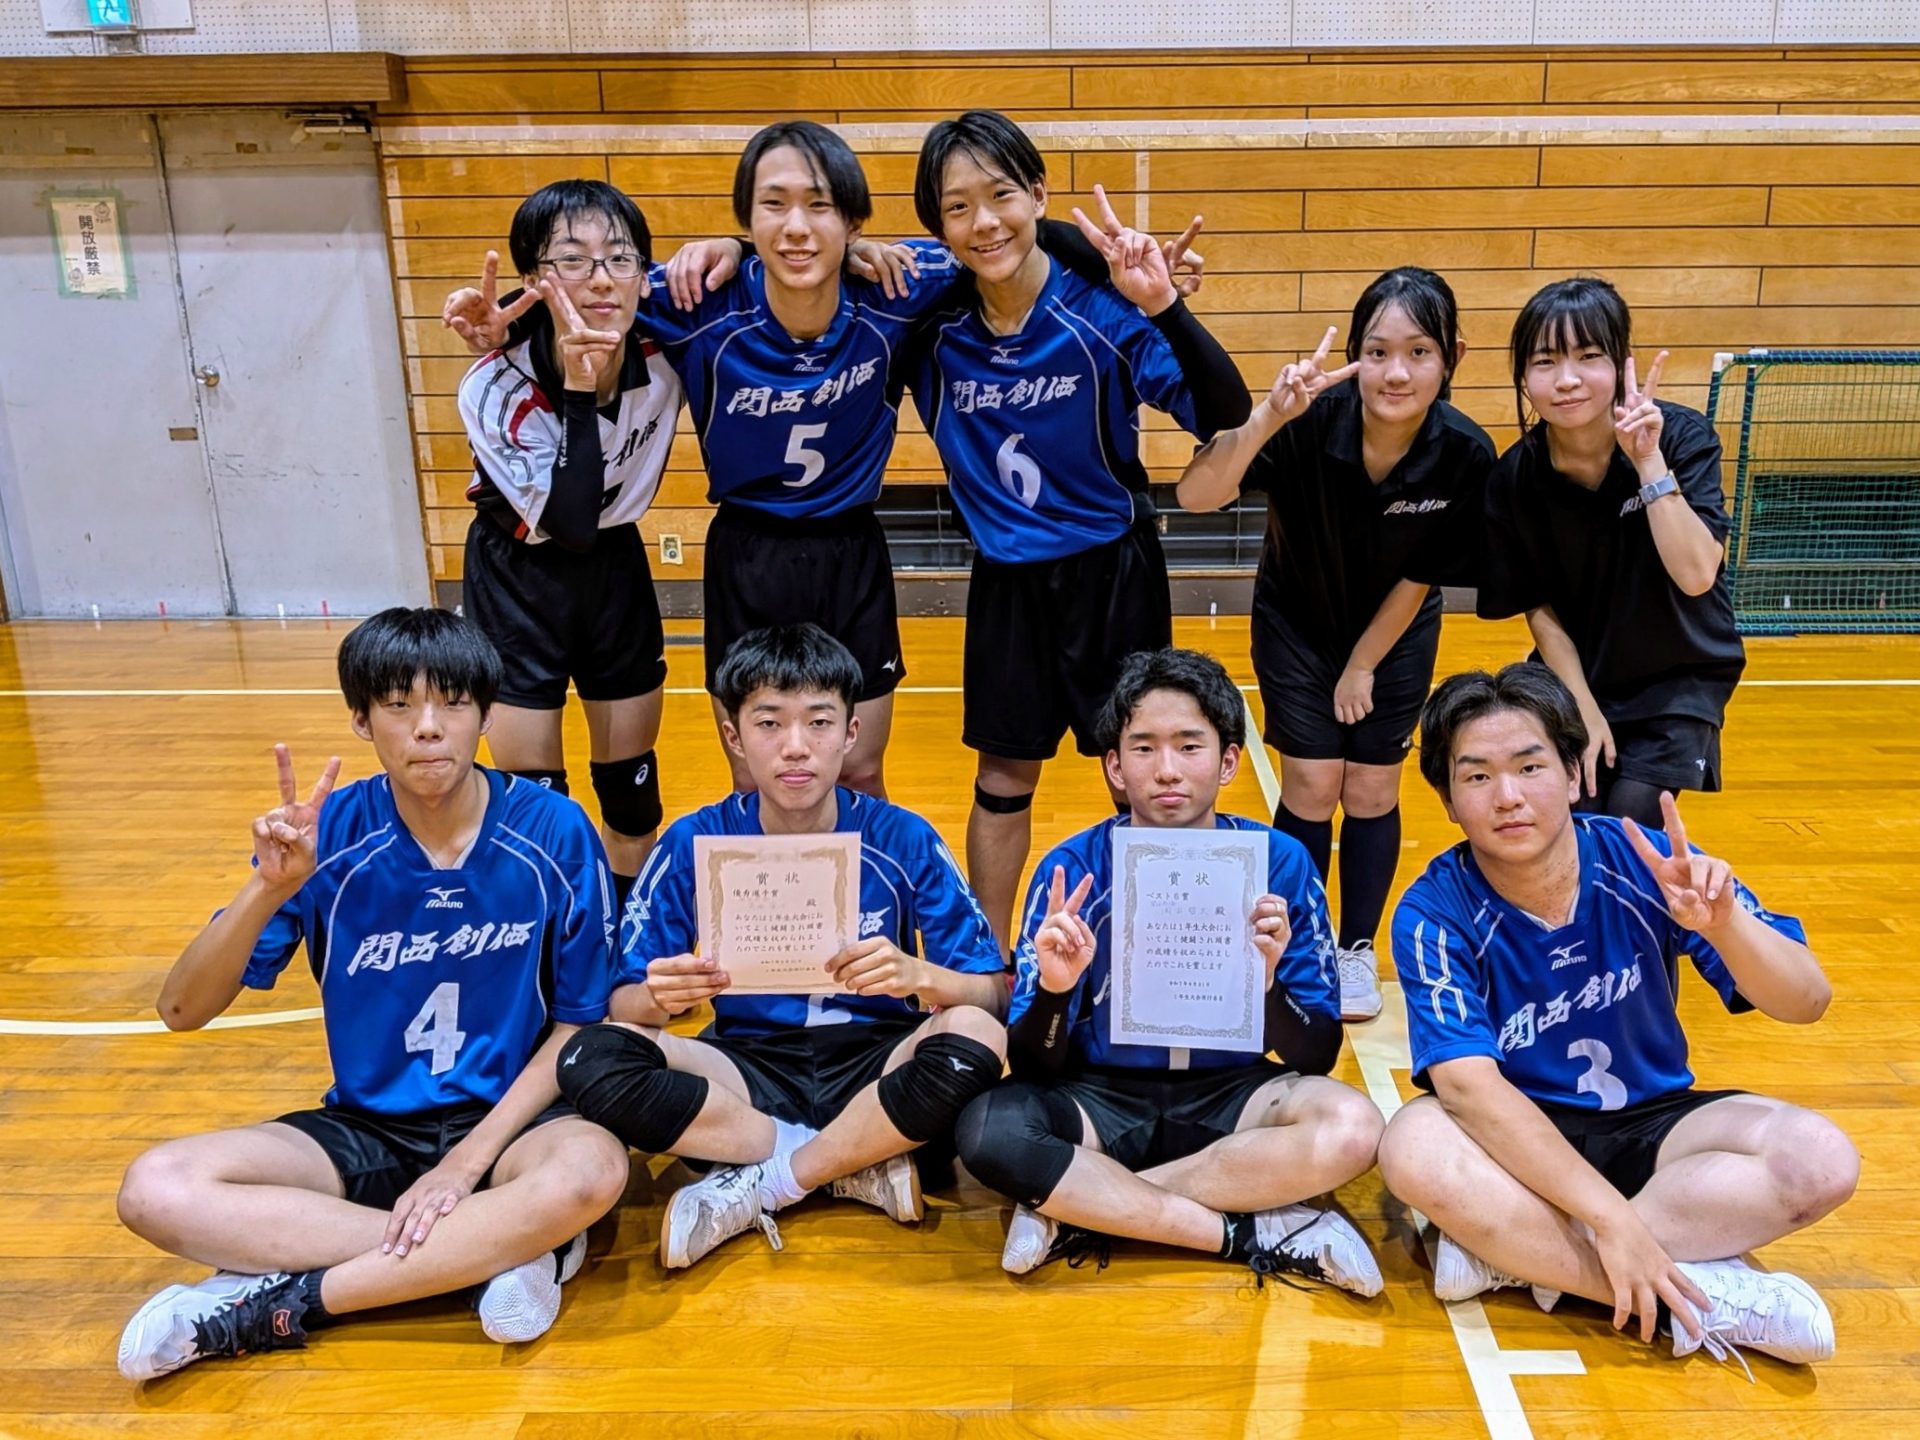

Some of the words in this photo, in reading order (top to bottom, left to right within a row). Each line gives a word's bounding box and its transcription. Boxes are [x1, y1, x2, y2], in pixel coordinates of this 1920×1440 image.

[78, 214, 102, 276] 開放厳禁
[726, 357, 882, 418] 関西創価
[952, 374, 1083, 415] 関西創価
[782, 422, 828, 487] 5
[996, 433, 1041, 509] 6
[347, 920, 538, 977] 関西創価
[404, 982, 467, 1076] 4
[1497, 953, 1645, 1053] 関西創価
[1567, 1038, 1628, 1111] 3
